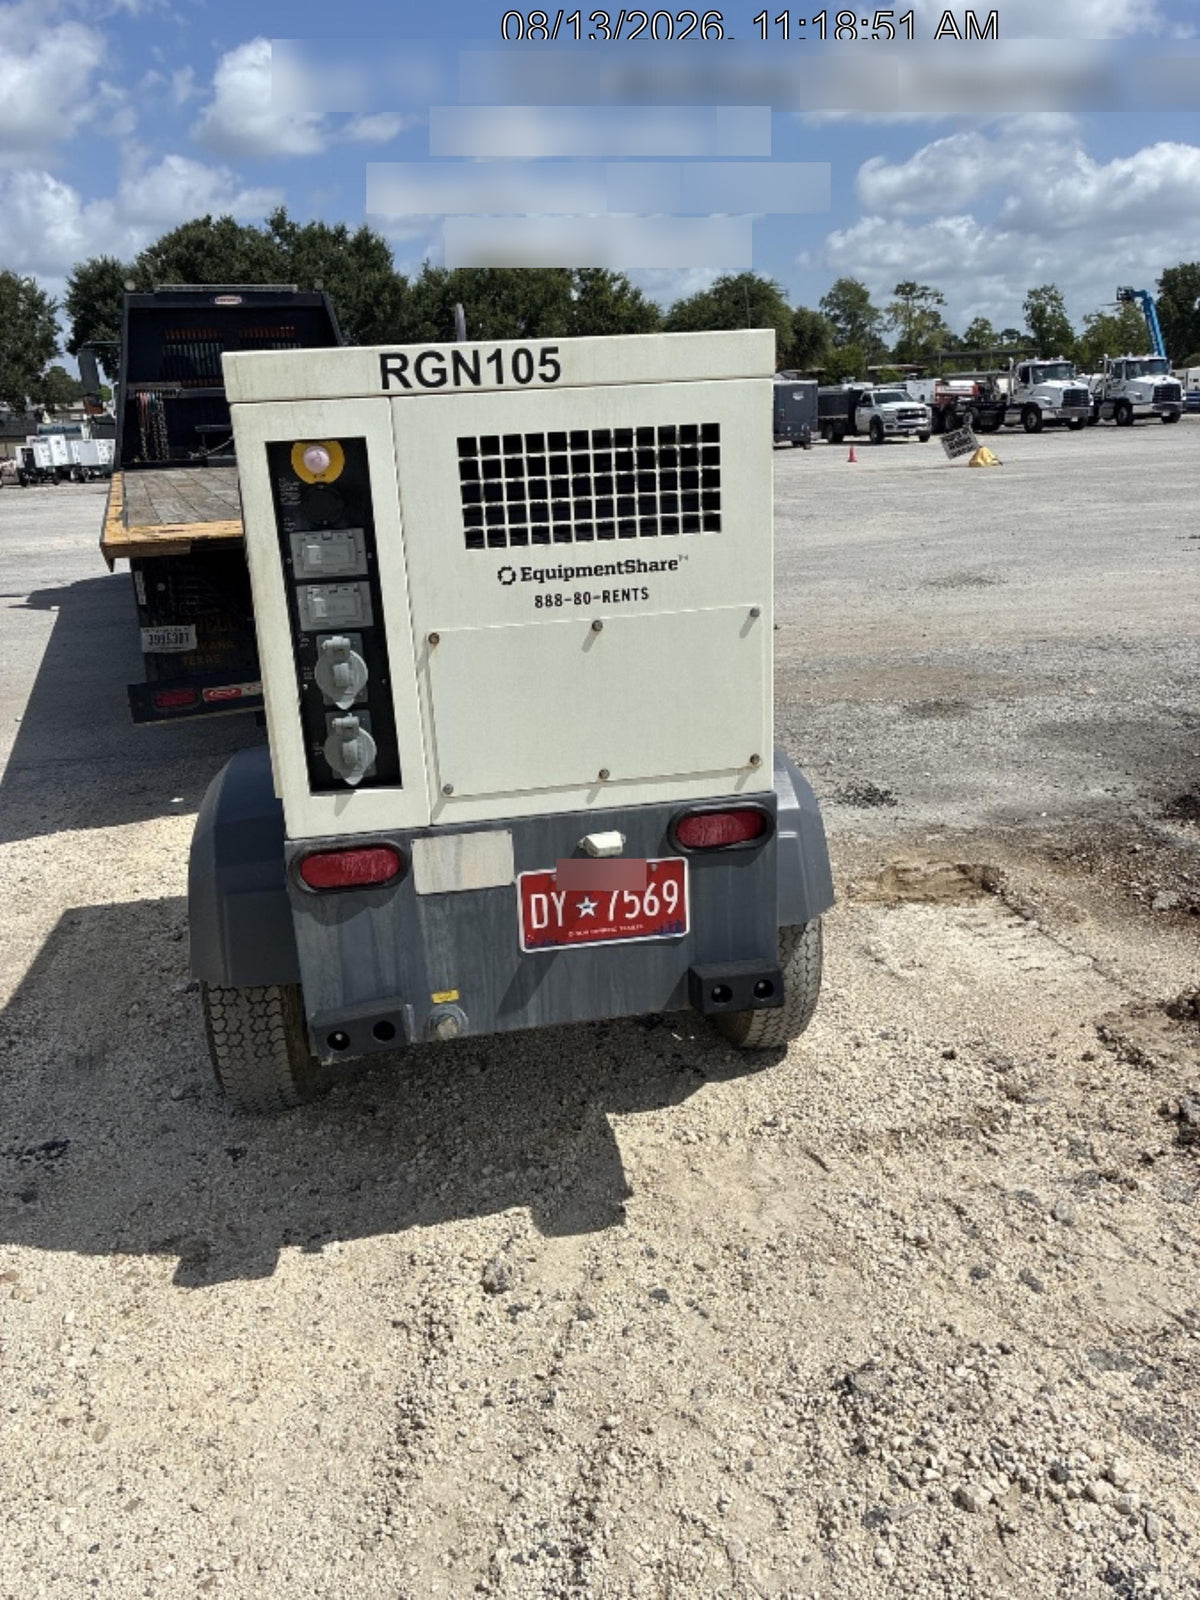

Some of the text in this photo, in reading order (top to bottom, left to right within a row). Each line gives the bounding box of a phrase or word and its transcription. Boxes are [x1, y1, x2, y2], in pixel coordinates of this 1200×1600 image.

[379, 346, 561, 390] RGN105
[520, 558, 680, 583] EquipmentShare
[534, 587, 650, 608] 888-80-RENTS
[530, 879, 679, 929] DY 7569
